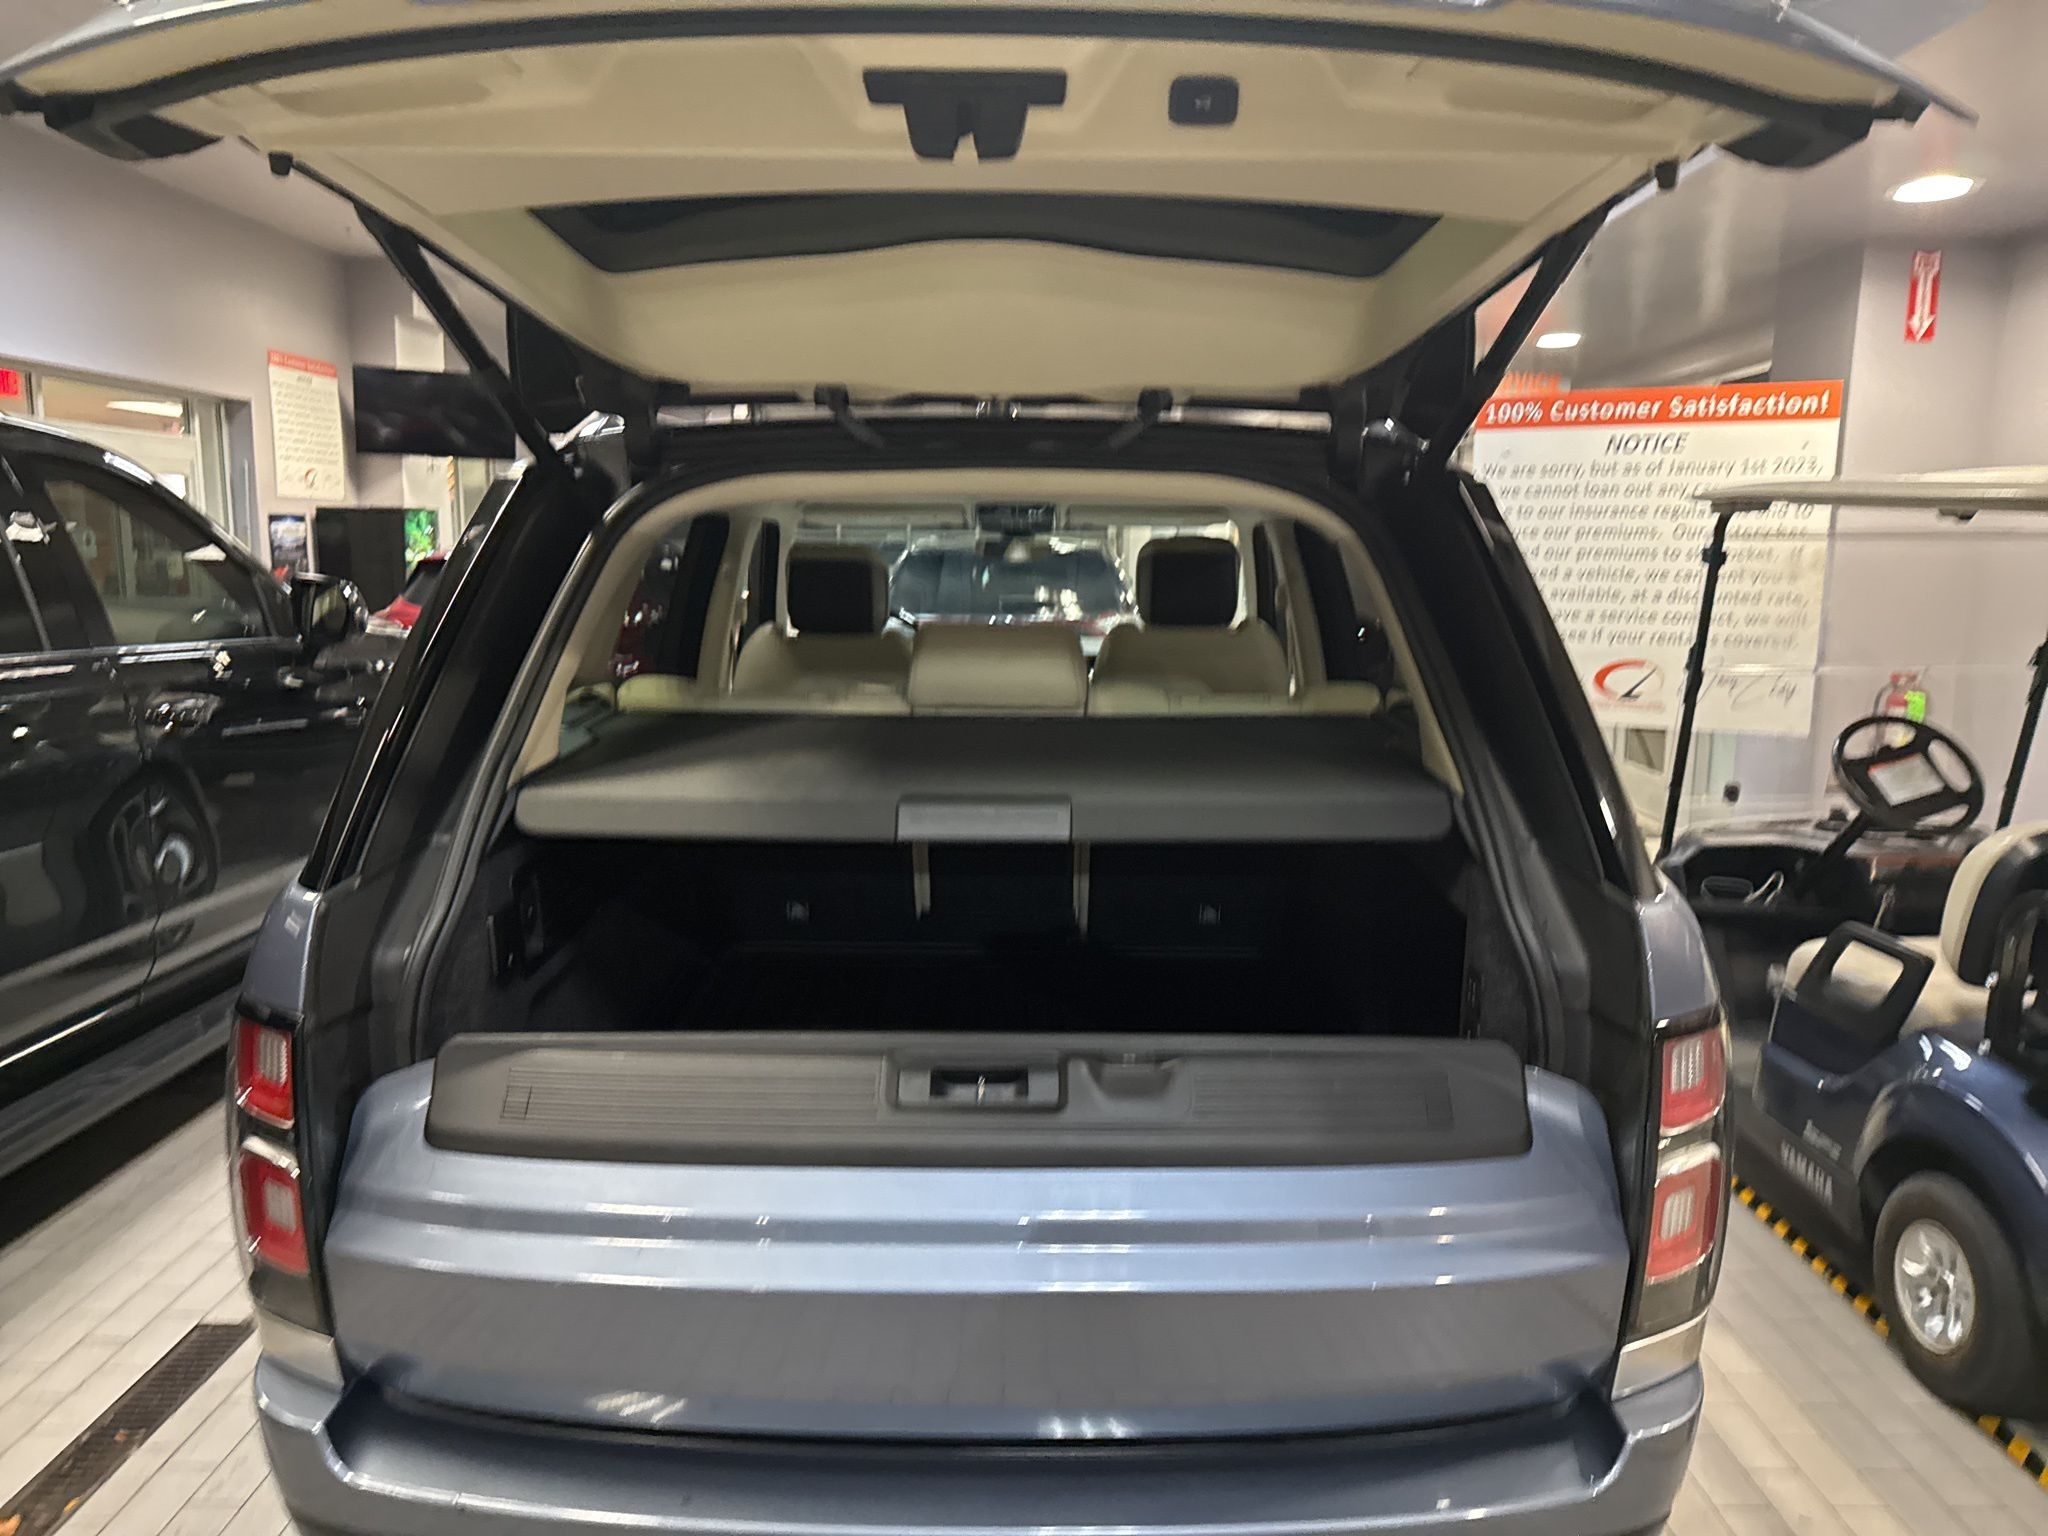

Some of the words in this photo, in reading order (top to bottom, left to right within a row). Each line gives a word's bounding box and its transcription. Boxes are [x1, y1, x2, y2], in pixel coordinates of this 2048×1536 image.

[1485, 400, 1544, 425] 100%
[1550, 399, 1663, 422] Customer
[1669, 389, 1830, 418] Satisfaction!
[1605, 432, 1690, 455] NOTICE
[1484, 462, 1506, 479] We
[1510, 463, 1536, 479] are
[1540, 462, 1586, 480] sorry,
[1590, 459, 1618, 477] but
[1622, 461, 1641, 477] as
[1645, 458, 1664, 477] of
[1667, 458, 1736, 478] January
[1524, 482, 1579, 499] cannot
[1584, 480, 1620, 498] loan
[1624, 481, 1653, 498] out
[1657, 482, 1689, 500] any
[1537, 504, 1567, 520] our
[1570, 502, 1650, 520] insurance
[1543, 525, 1572, 541] our
[1673, 523, 1707, 540] Our
[1544, 546, 1573, 562] our
[1576, 543, 1659, 563] premiums
[1663, 546, 1682, 562] to
[1577, 565, 1640, 584] vehicle,
[1646, 567, 1671, 583] we
[1550, 585, 1626, 604] available,
[1599, 606, 1659, 625] service
[1607, 630, 1645, 648] your
